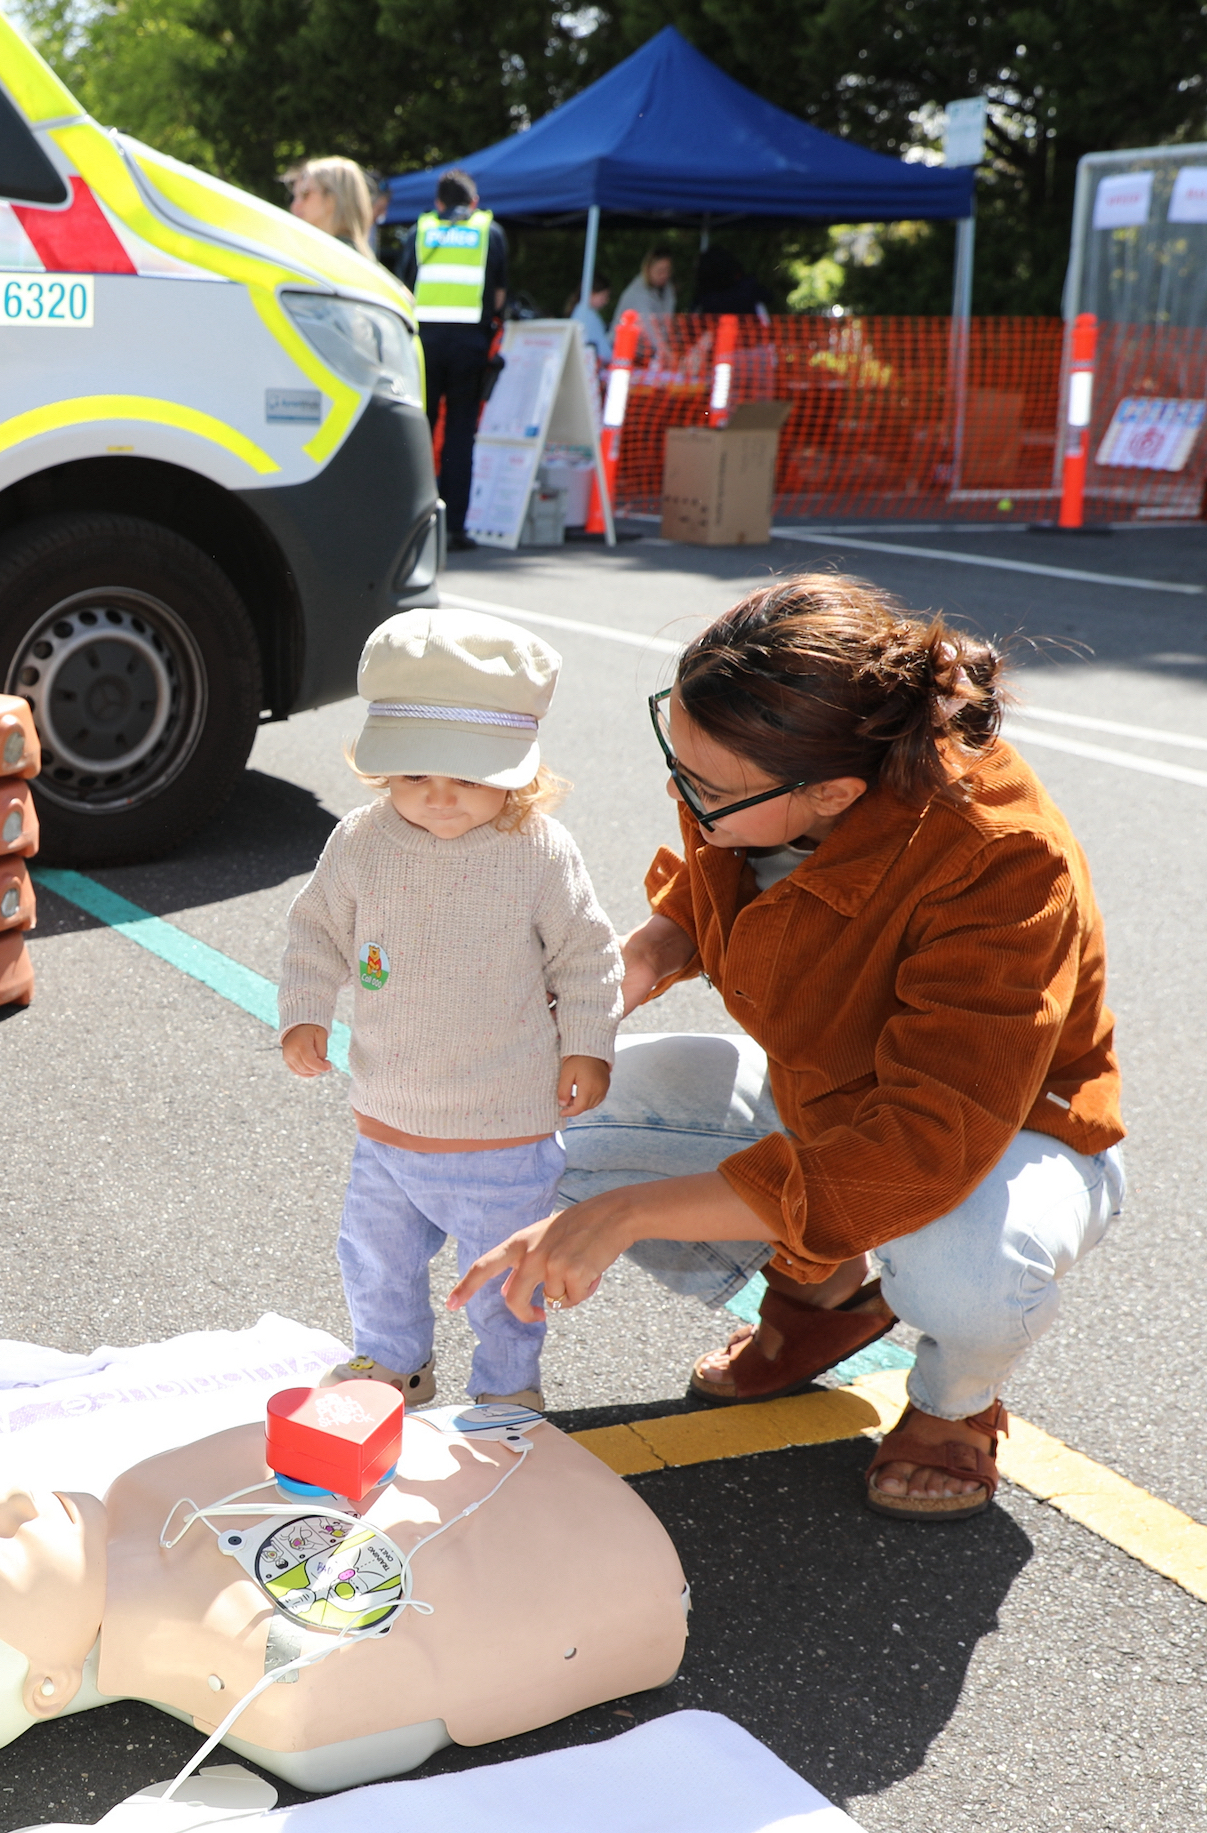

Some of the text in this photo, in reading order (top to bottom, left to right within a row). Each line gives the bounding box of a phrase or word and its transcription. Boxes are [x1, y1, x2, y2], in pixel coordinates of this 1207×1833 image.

[4, 281, 87, 320] 6320
[361, 973, 383, 989] Call 000
[367, 1546, 391, 1572] TRAINING
[378, 1547, 395, 1562] ONLY
